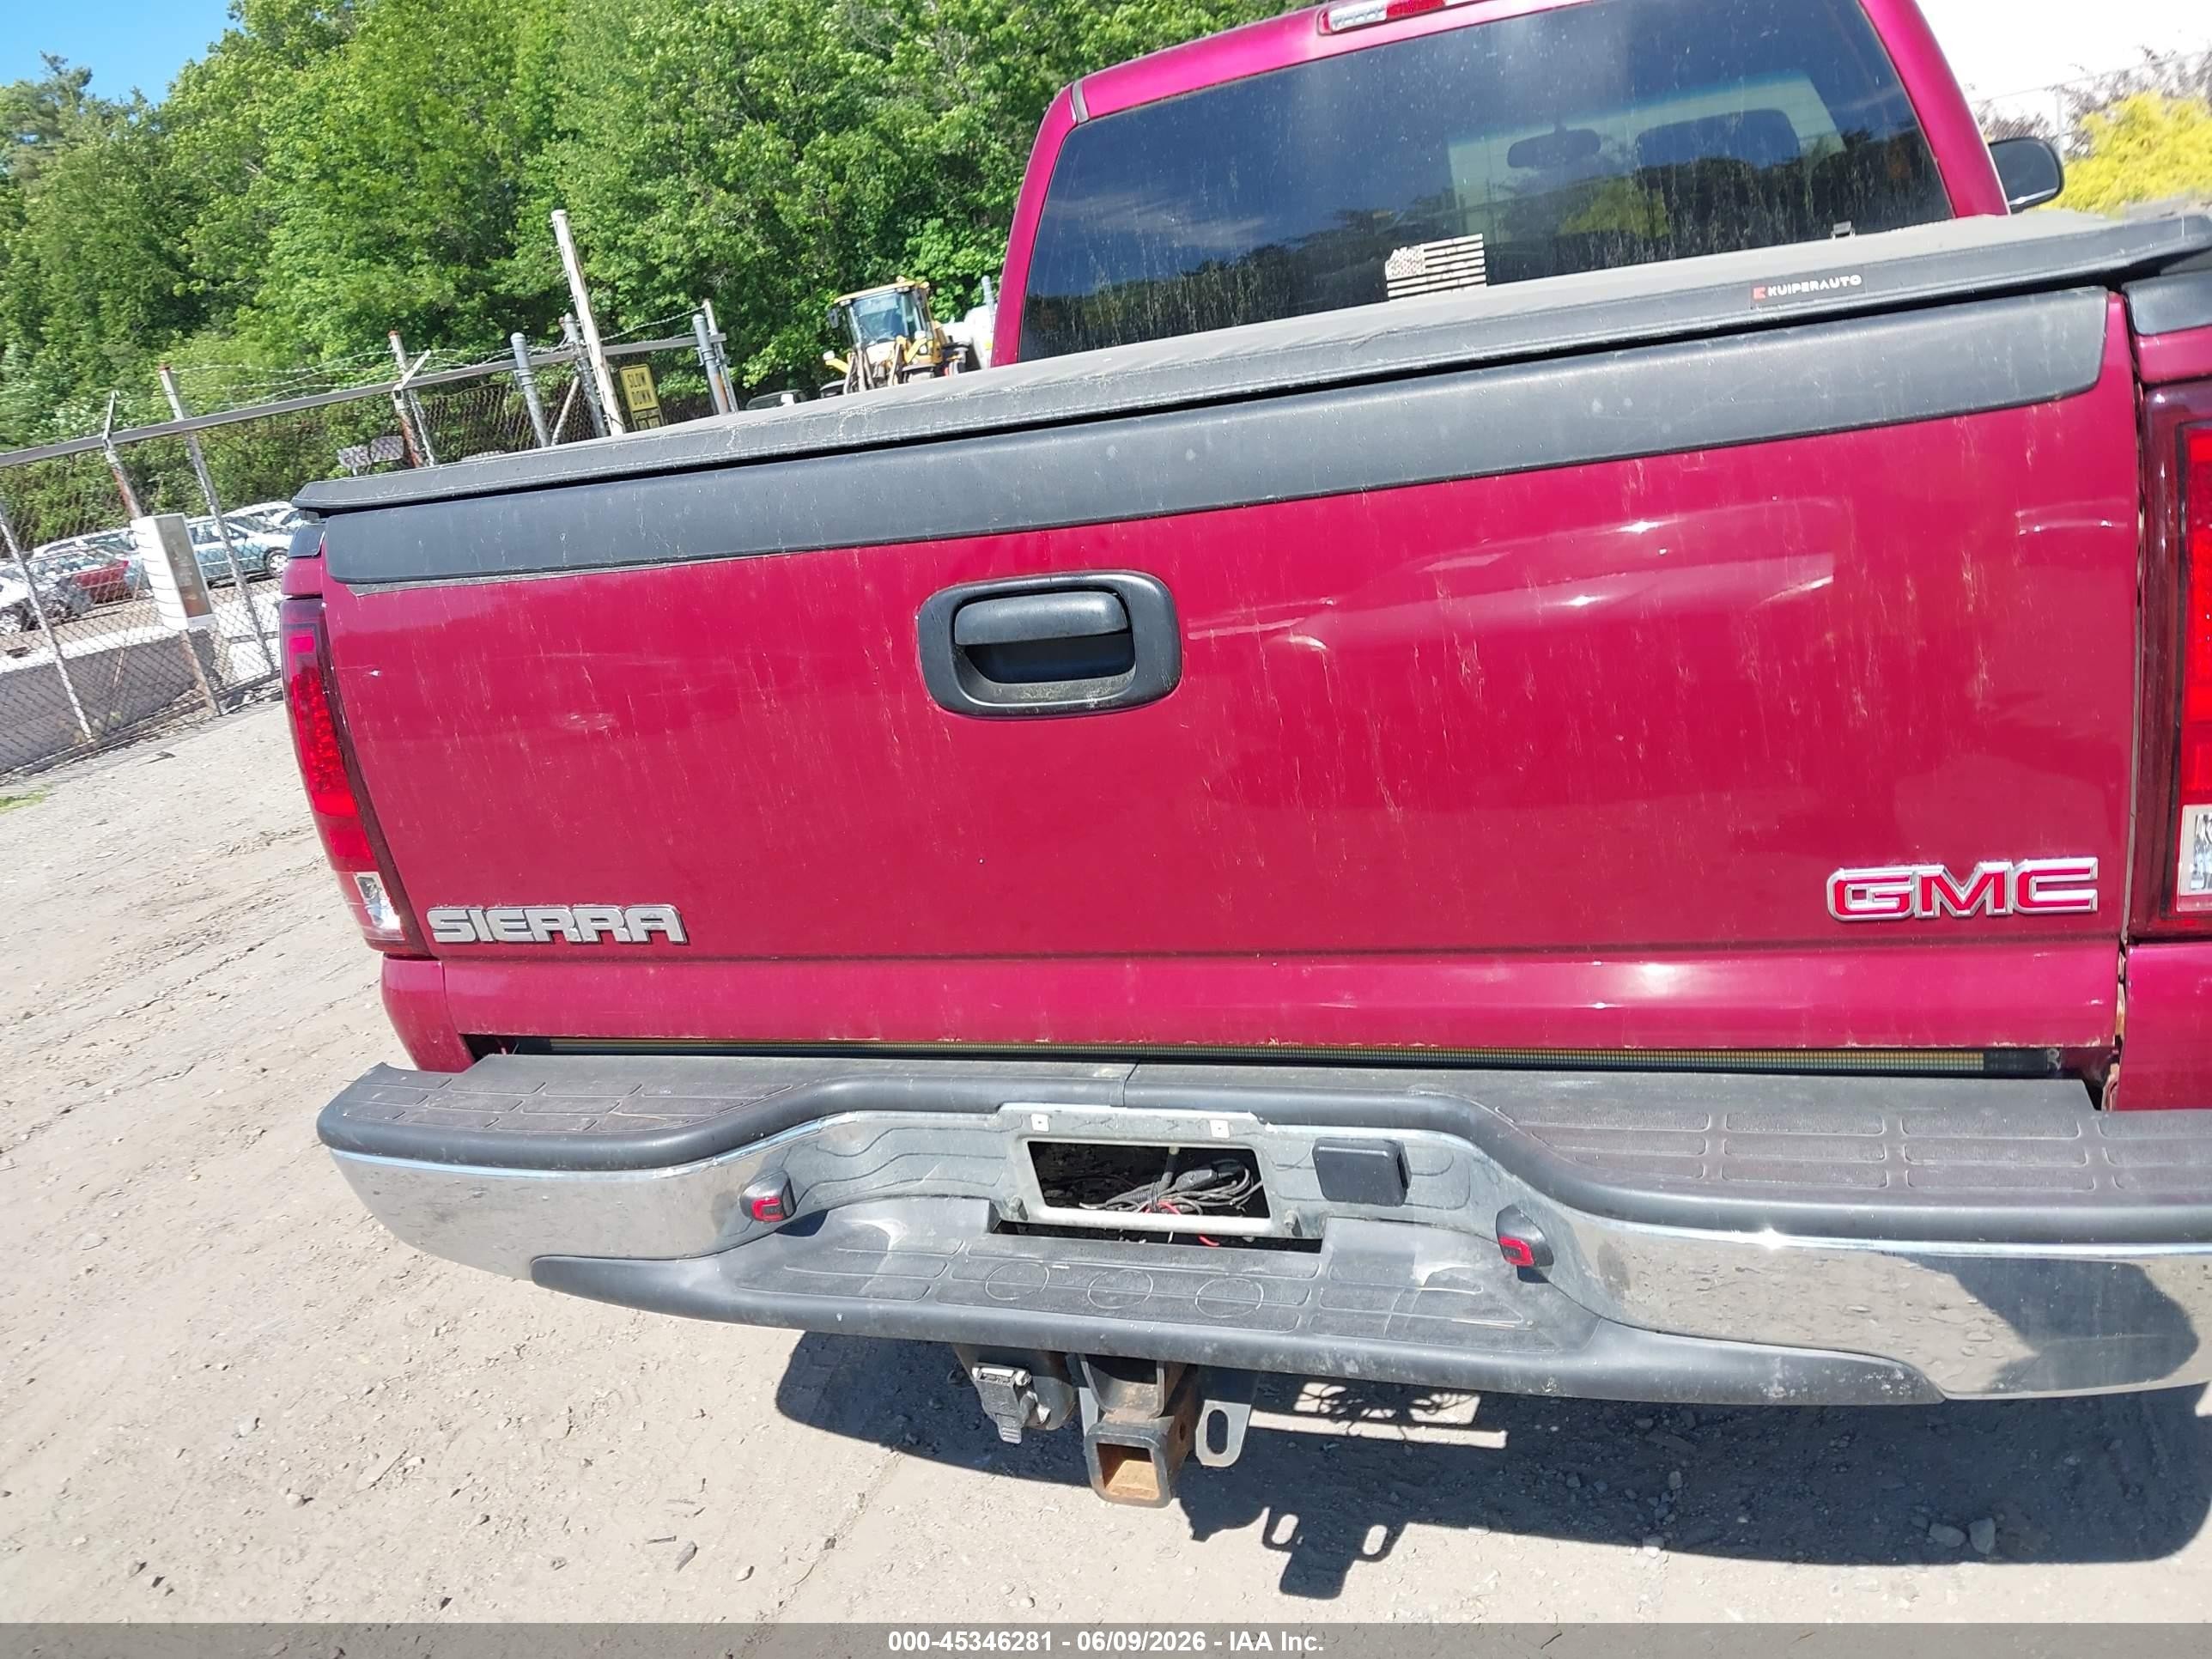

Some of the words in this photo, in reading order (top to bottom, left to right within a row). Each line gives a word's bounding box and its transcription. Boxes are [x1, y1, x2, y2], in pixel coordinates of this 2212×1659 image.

[1767, 273, 1863, 297] KUIPERAUTO
[1826, 857, 2099, 921] GMC
[427, 903, 688, 945] SIERRA
